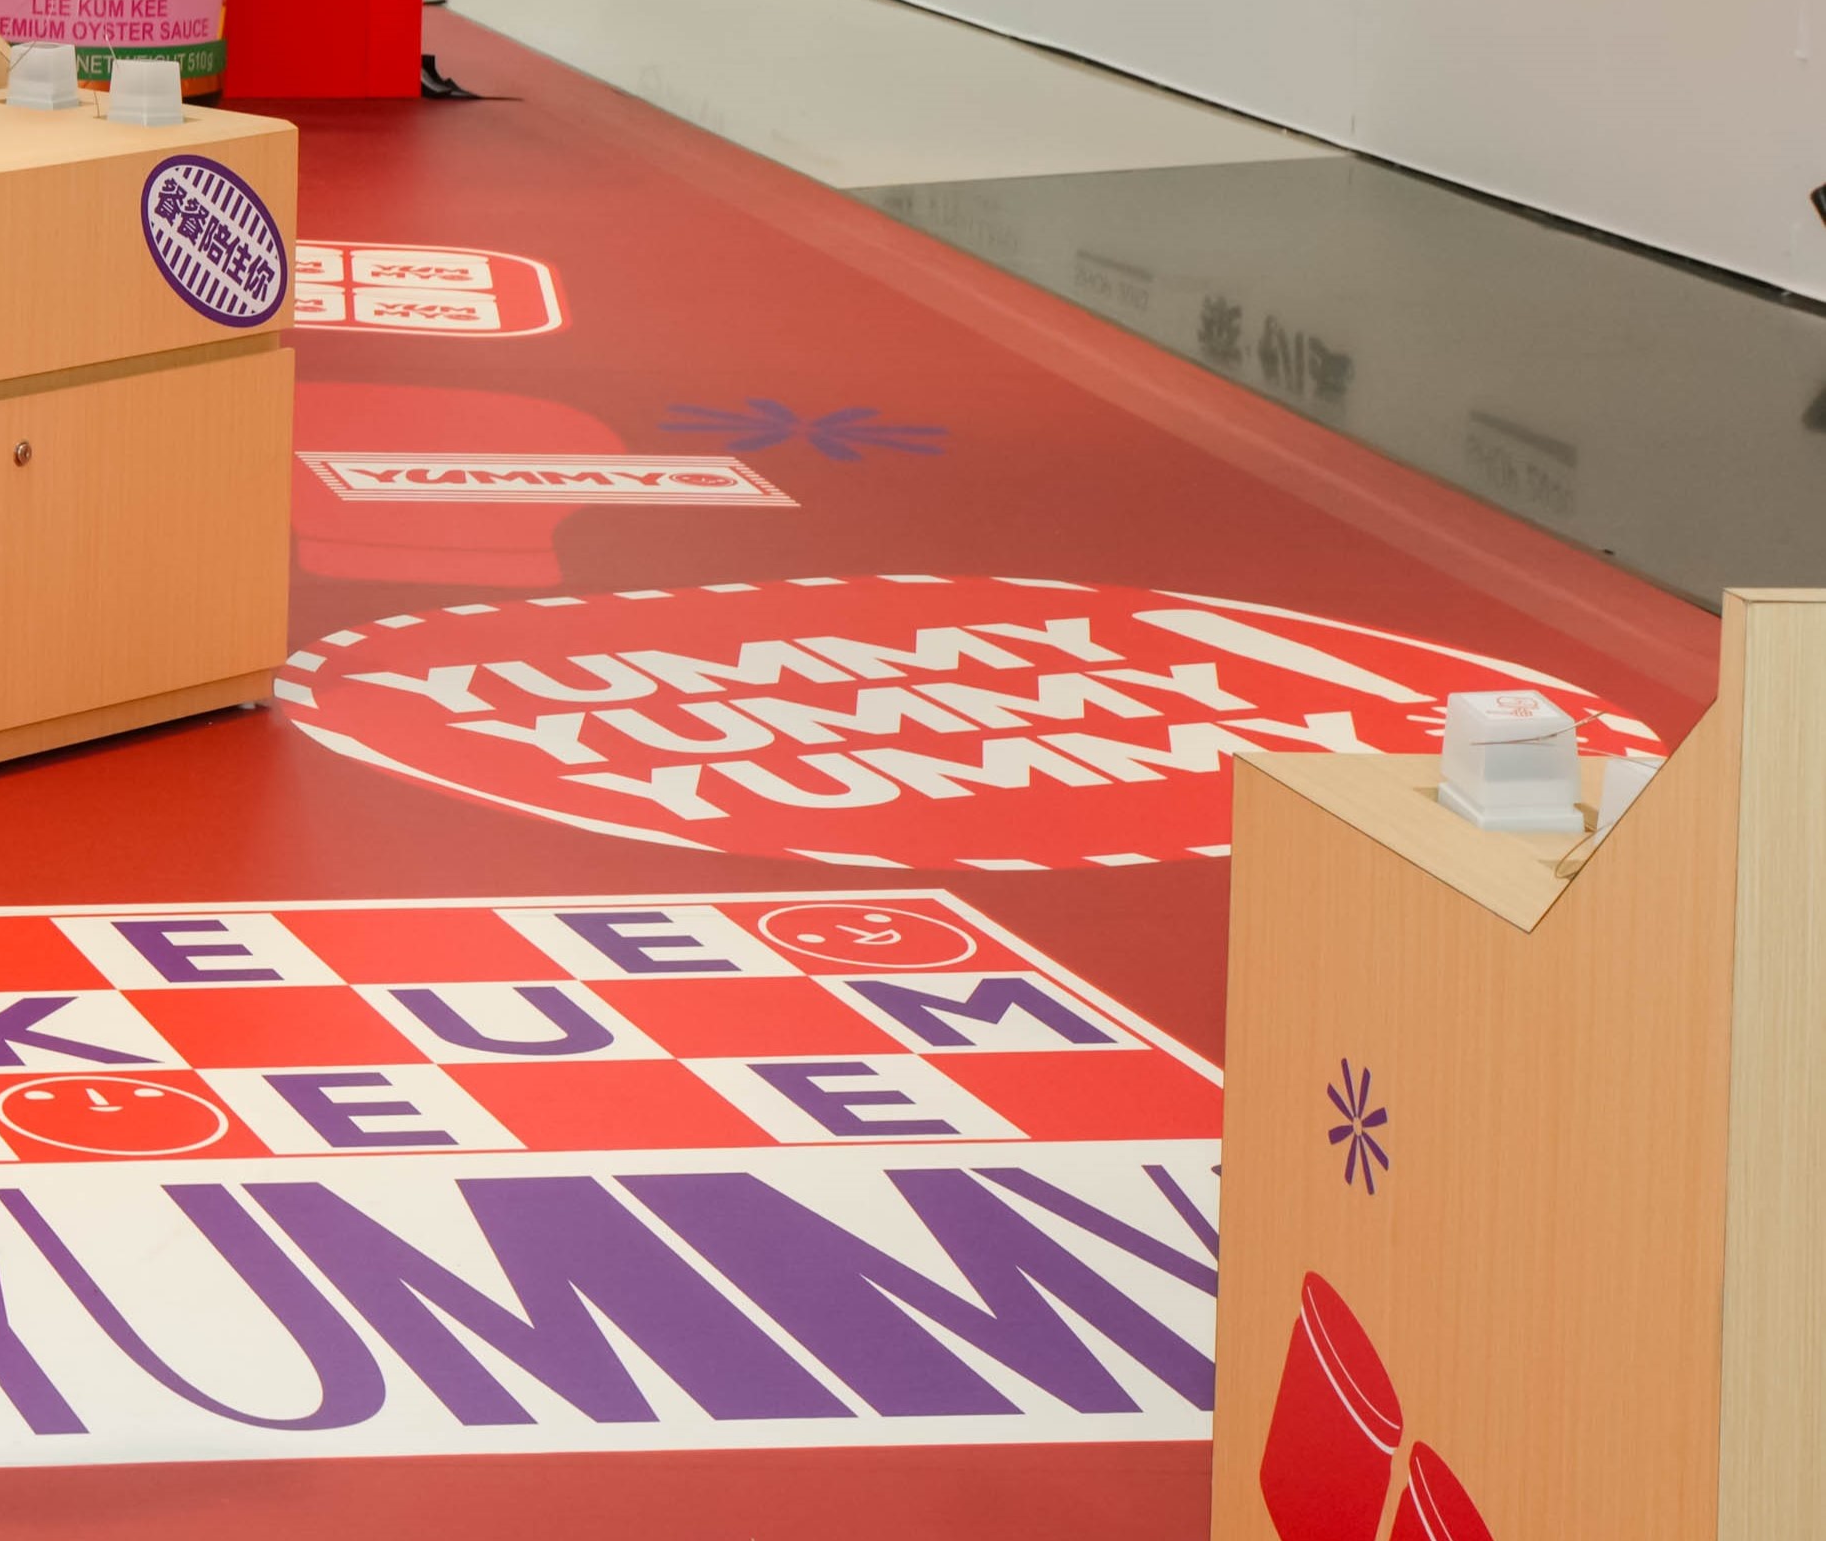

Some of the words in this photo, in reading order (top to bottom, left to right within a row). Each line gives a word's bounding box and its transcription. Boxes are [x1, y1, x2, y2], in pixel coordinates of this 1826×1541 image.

[72, 22, 154, 42] OYSTER
[160, 17, 210, 40] SAUCE
[154, 177, 276, 302] 餐餐陪住你
[347, 467, 674, 488] YUMMY
[344, 617, 1132, 716] YUMMY
[451, 662, 1260, 768] YUMMY
